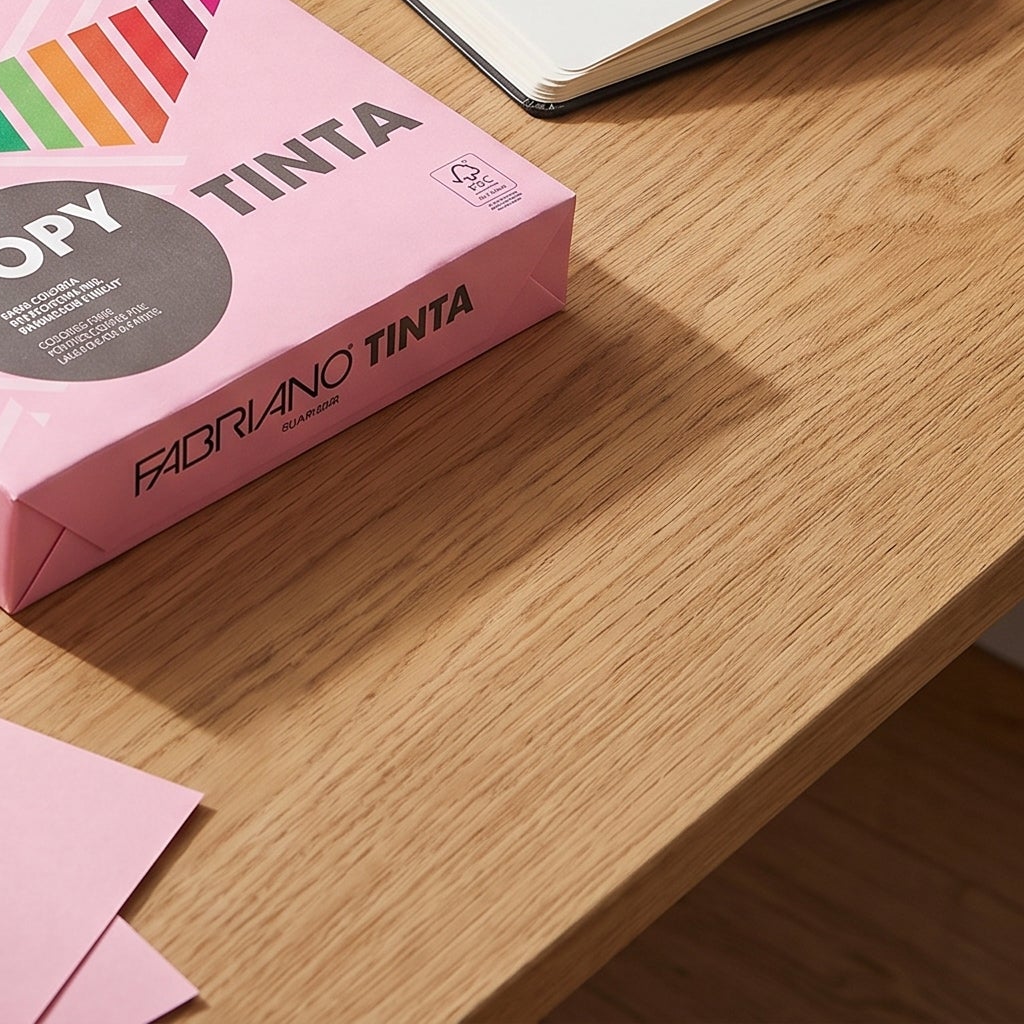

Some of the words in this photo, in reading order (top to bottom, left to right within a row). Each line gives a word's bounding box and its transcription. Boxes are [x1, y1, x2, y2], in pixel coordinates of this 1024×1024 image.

[190, 102, 424, 217] TINTA
[134, 347, 354, 498] FABRIANO
[364, 283, 475, 368] TINTA
